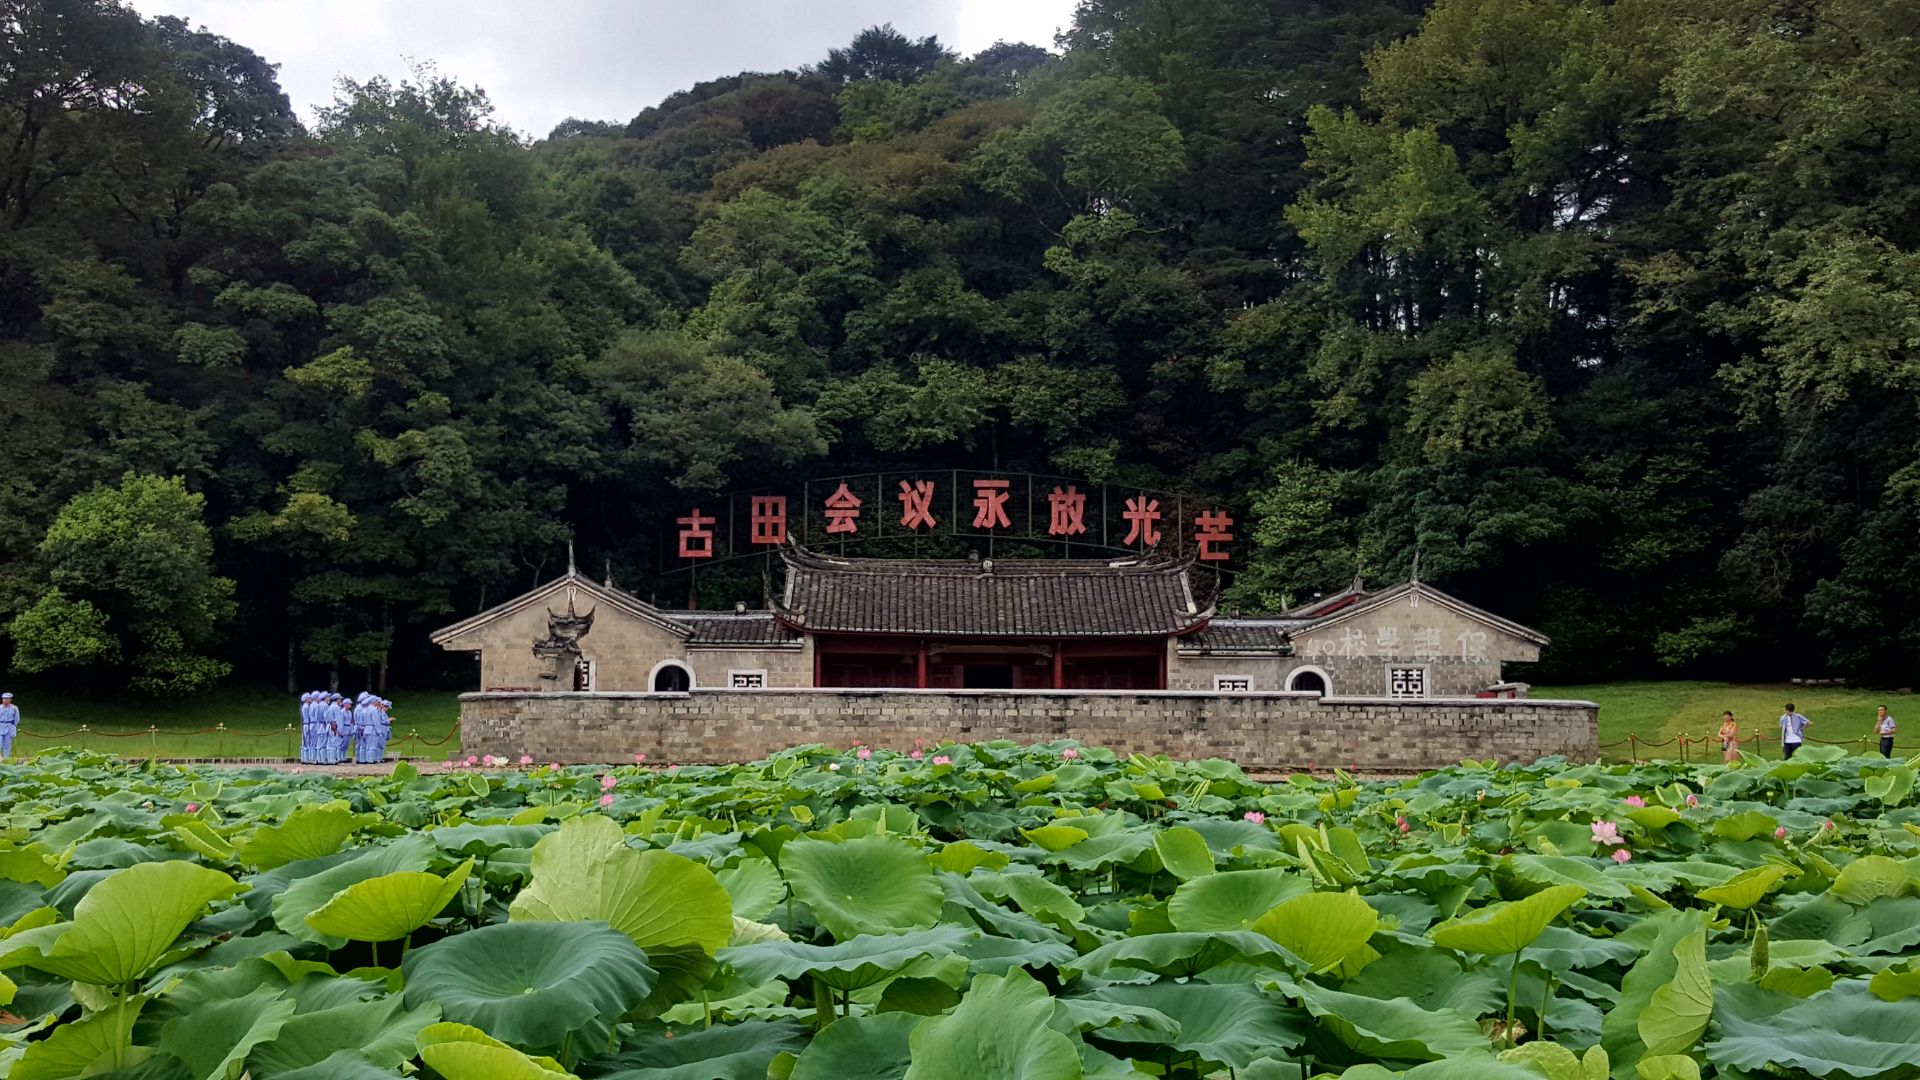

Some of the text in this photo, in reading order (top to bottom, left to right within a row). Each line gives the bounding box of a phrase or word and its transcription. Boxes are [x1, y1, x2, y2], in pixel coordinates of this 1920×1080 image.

[676, 480, 1234, 560] 古田会议永放光芒
